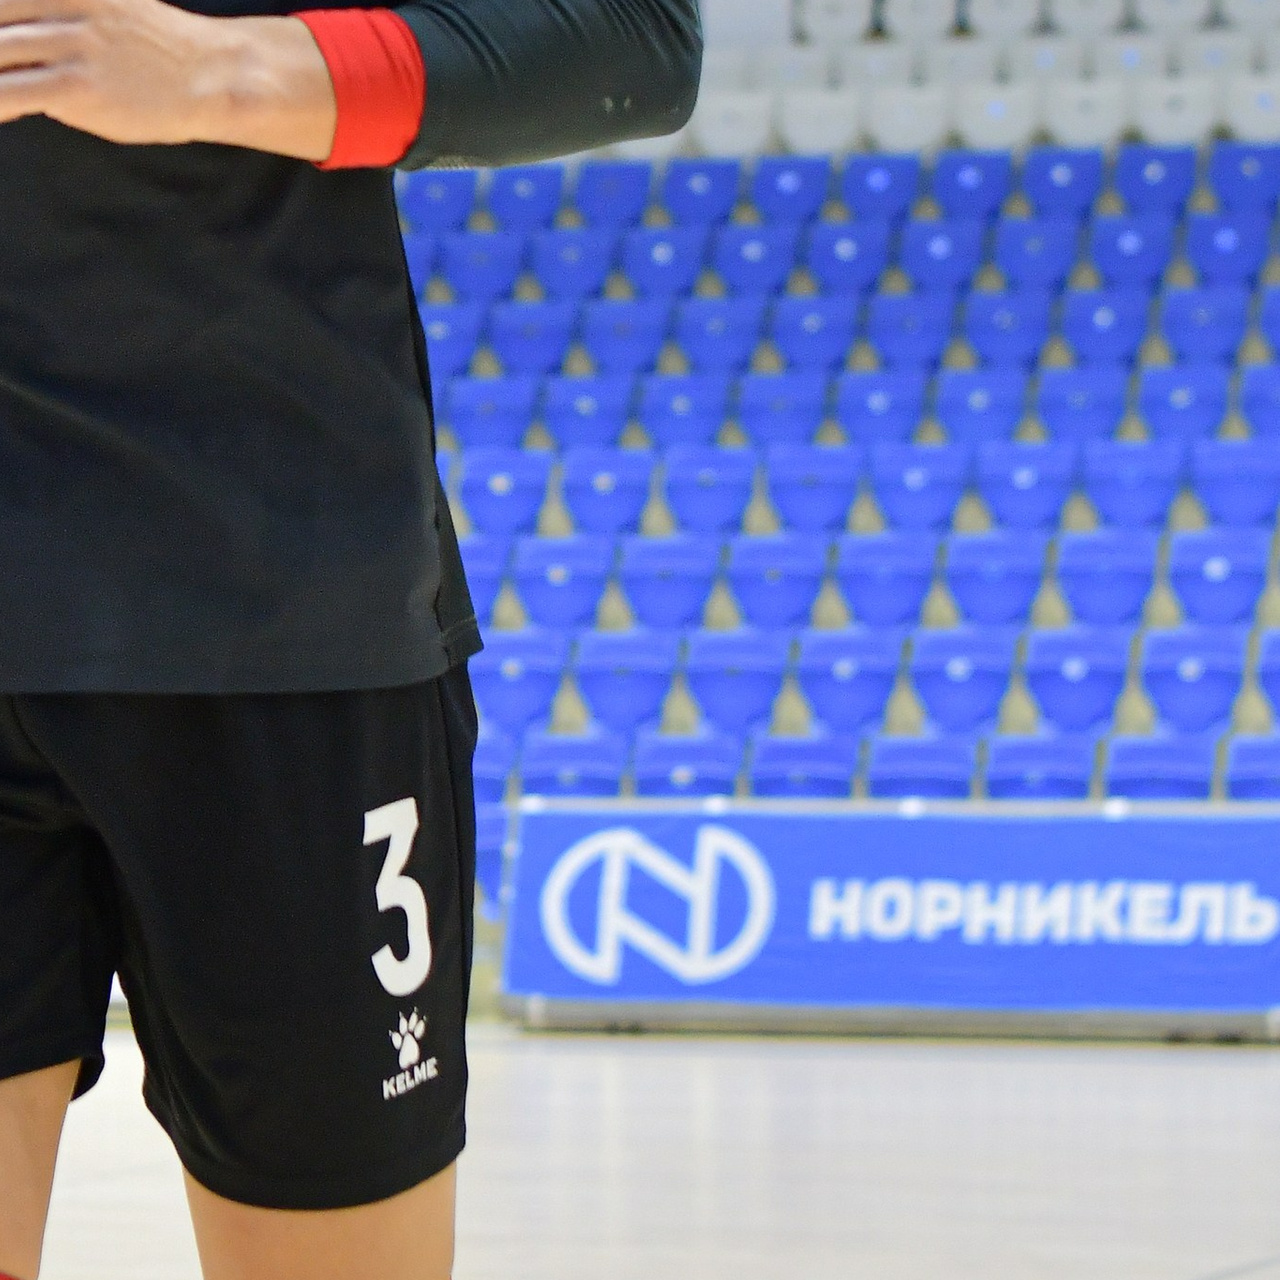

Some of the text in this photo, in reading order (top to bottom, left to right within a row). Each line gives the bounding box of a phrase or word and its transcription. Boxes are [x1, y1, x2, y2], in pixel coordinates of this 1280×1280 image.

[363, 797, 433, 997] 3
[808, 876, 1280, 945] НОРНИКЕЛЬ
[383, 1057, 439, 1101] KELME
